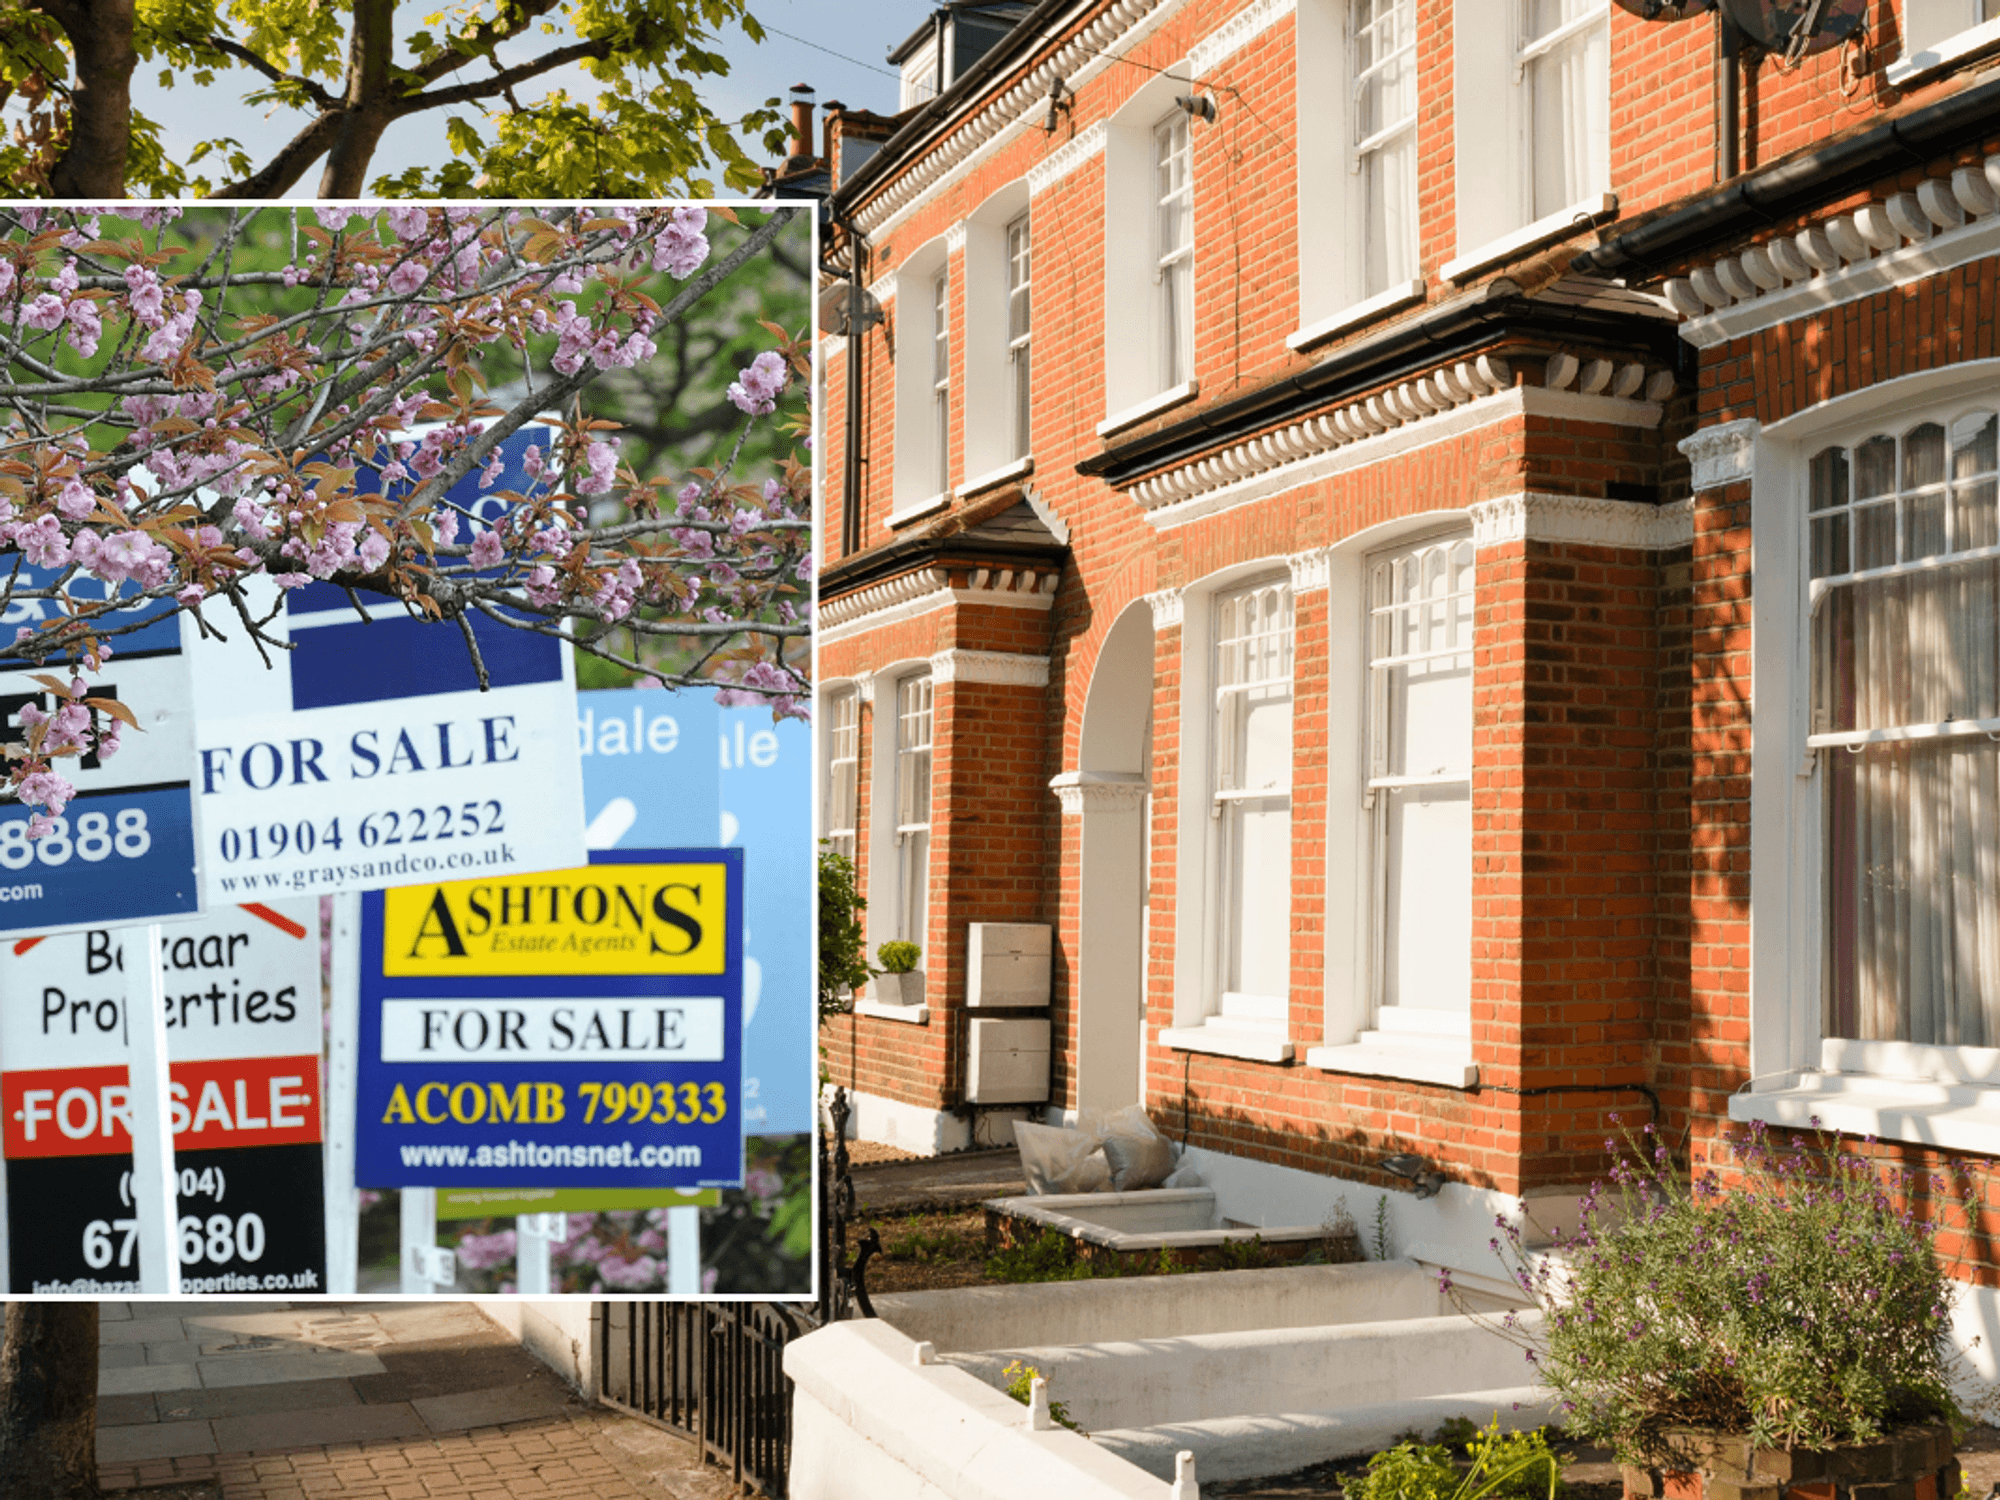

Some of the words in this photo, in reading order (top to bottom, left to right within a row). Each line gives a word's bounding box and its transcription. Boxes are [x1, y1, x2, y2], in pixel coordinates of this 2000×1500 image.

[199, 738, 330, 795] FOR
[349, 714, 521, 779] SALE
[576, 705, 680, 756] dale
[220, 817, 344, 863] 01904
[358, 799, 506, 849] 622252
[219, 842, 517, 892] www.graysandco.co.uk
[405, 883, 704, 959] ASHTONS
[489, 930, 559, 953] Estate
[560, 930, 639, 958] Agents
[86, 930, 250, 975] Baar
[42, 978, 297, 1048] Prorties
[419, 1008, 531, 1052] FOR
[547, 1007, 688, 1052] SALE
[22, 1086, 135, 1141] FOR
[170, 1075, 306, 1135] SALE
[380, 1081, 567, 1125] ACOMB
[577, 1080, 728, 1125] 799333
[399, 1139, 703, 1169] www.ashtonsnet.com
[119, 1166, 226, 1208] (04)
[82, 1212, 266, 1270] 67680
